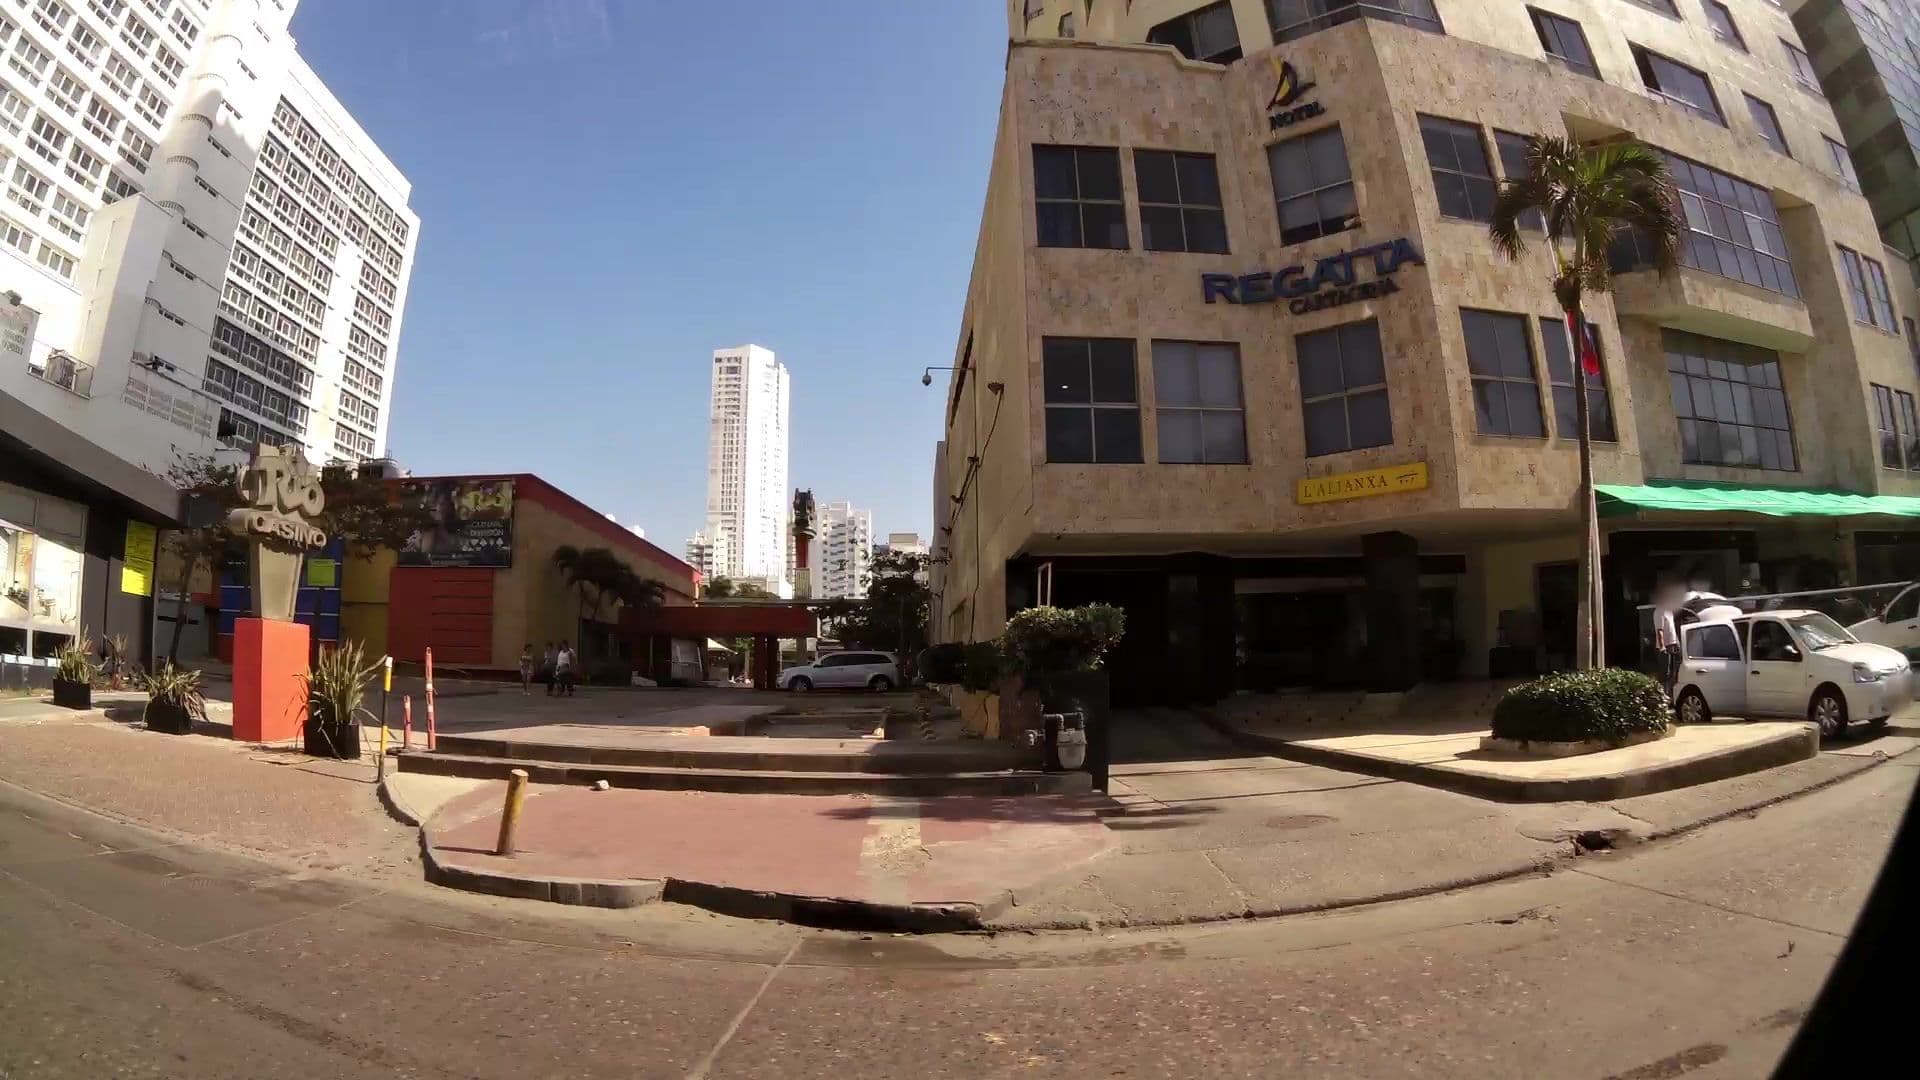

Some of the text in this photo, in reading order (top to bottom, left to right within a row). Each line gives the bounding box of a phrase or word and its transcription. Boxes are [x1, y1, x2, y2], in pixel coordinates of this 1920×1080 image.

[1268, 102, 1325, 131] HOTEL
[1201, 238, 1426, 305] REGATTA
[1303, 475, 1388, 499] L'ALIANXA
[250, 514, 327, 548] CASINO
